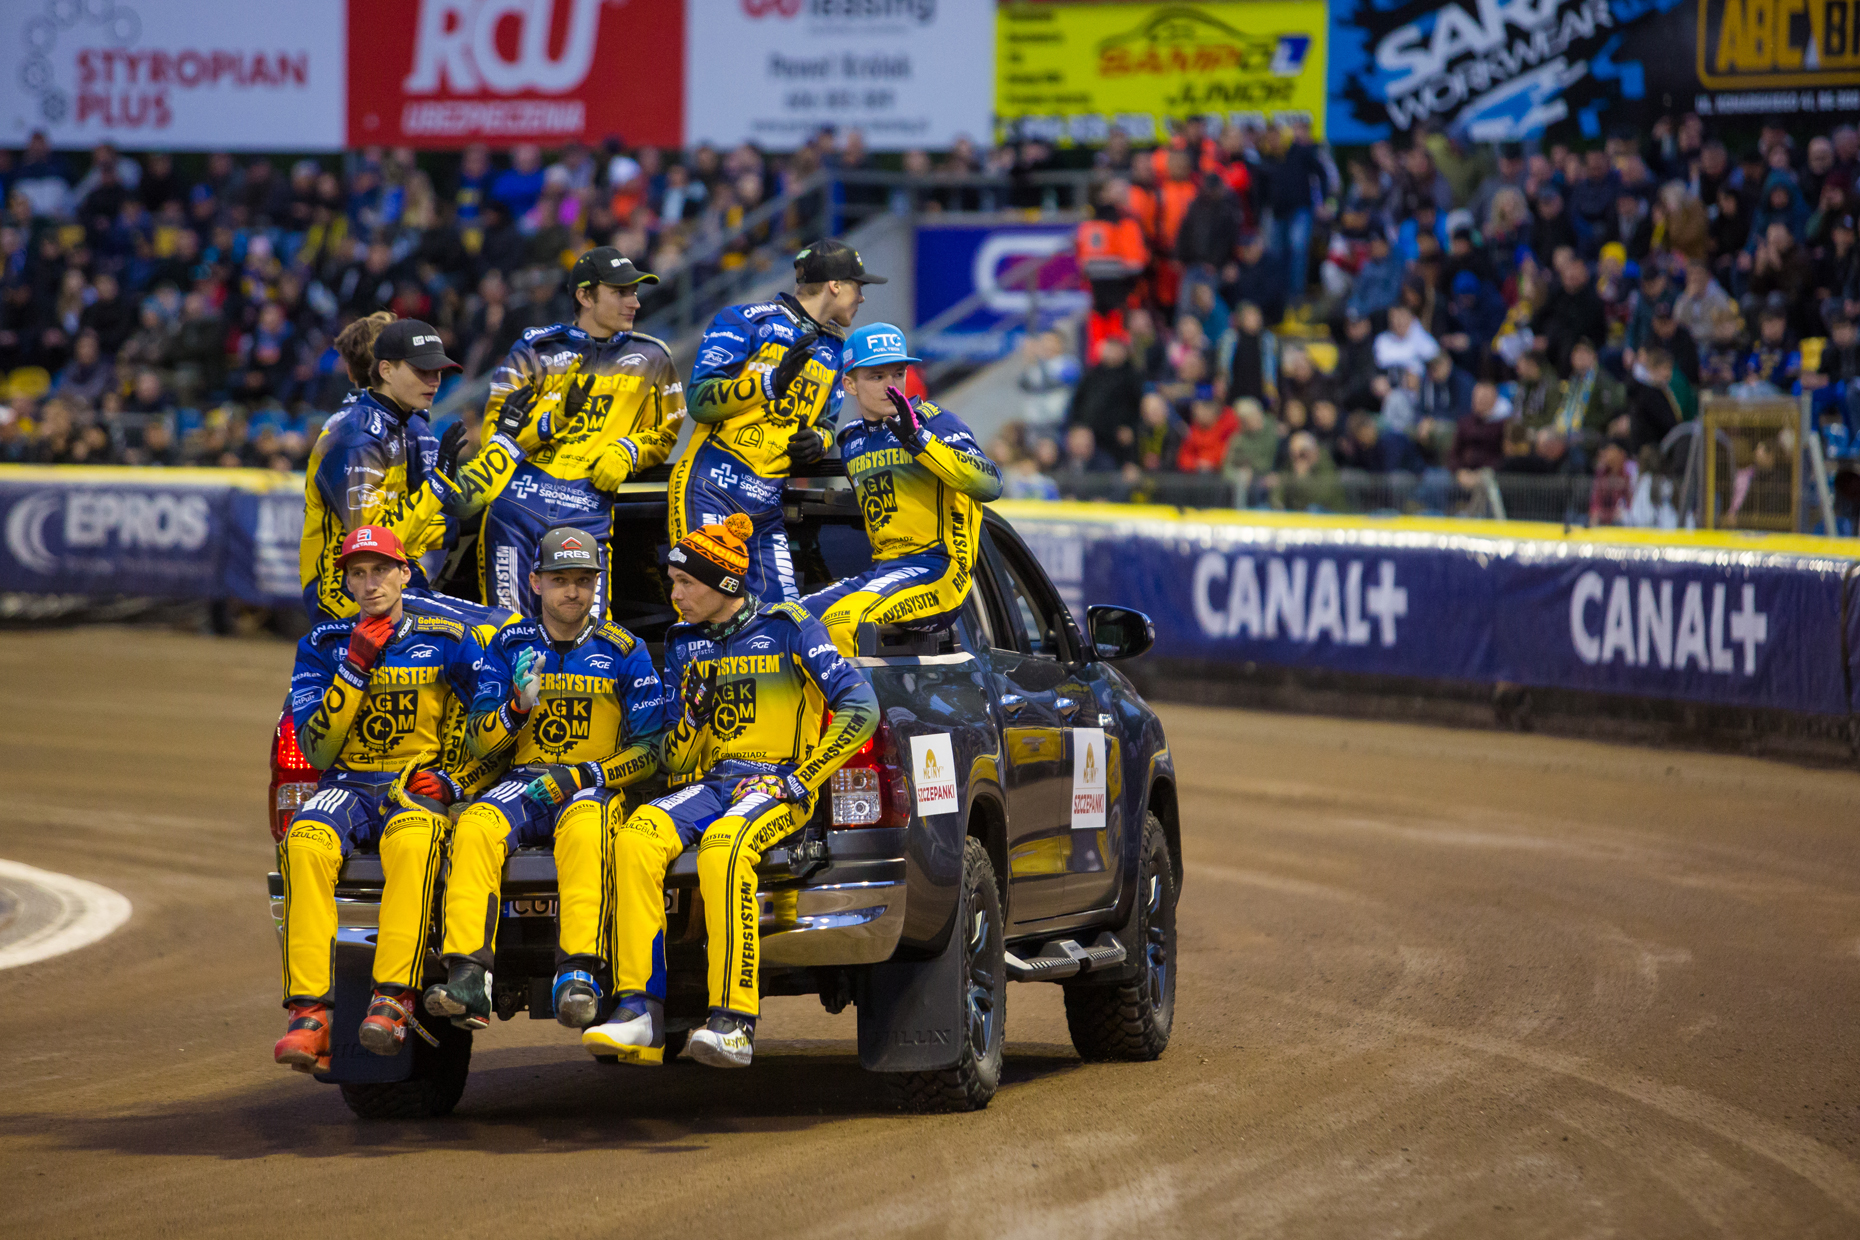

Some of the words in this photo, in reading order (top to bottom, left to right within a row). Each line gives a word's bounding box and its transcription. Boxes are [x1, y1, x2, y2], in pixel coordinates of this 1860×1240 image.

[75, 48, 309, 88] STYROPIAN
[75, 91, 173, 129] PLUS
[698, 377, 757, 406] AVO
[466, 449, 508, 499] AVO
[674, 460, 688, 542] KUBIAKPO
[64, 492, 209, 548] EPROS
[554, 551, 591, 560] PRES
[693, 535, 748, 569] RACING
[1195, 550, 1408, 647] CANAL+
[311, 624, 350, 646] CANAL+
[501, 626, 537, 645] ANAL+
[1570, 571, 1768, 677] CANAL+
[411, 649, 433, 659] PGE
[751, 641, 771, 650] PGE
[590, 659, 613, 670] PGE
[307, 684, 346, 754] AVO
[800, 711, 868, 782] BAYERSYSTEM
[917, 784, 955, 803] SZCZEPANKI
[1073, 793, 1105, 815] SZCZEPANKI
[739, 881, 754, 989] BAYERSYSTEM
